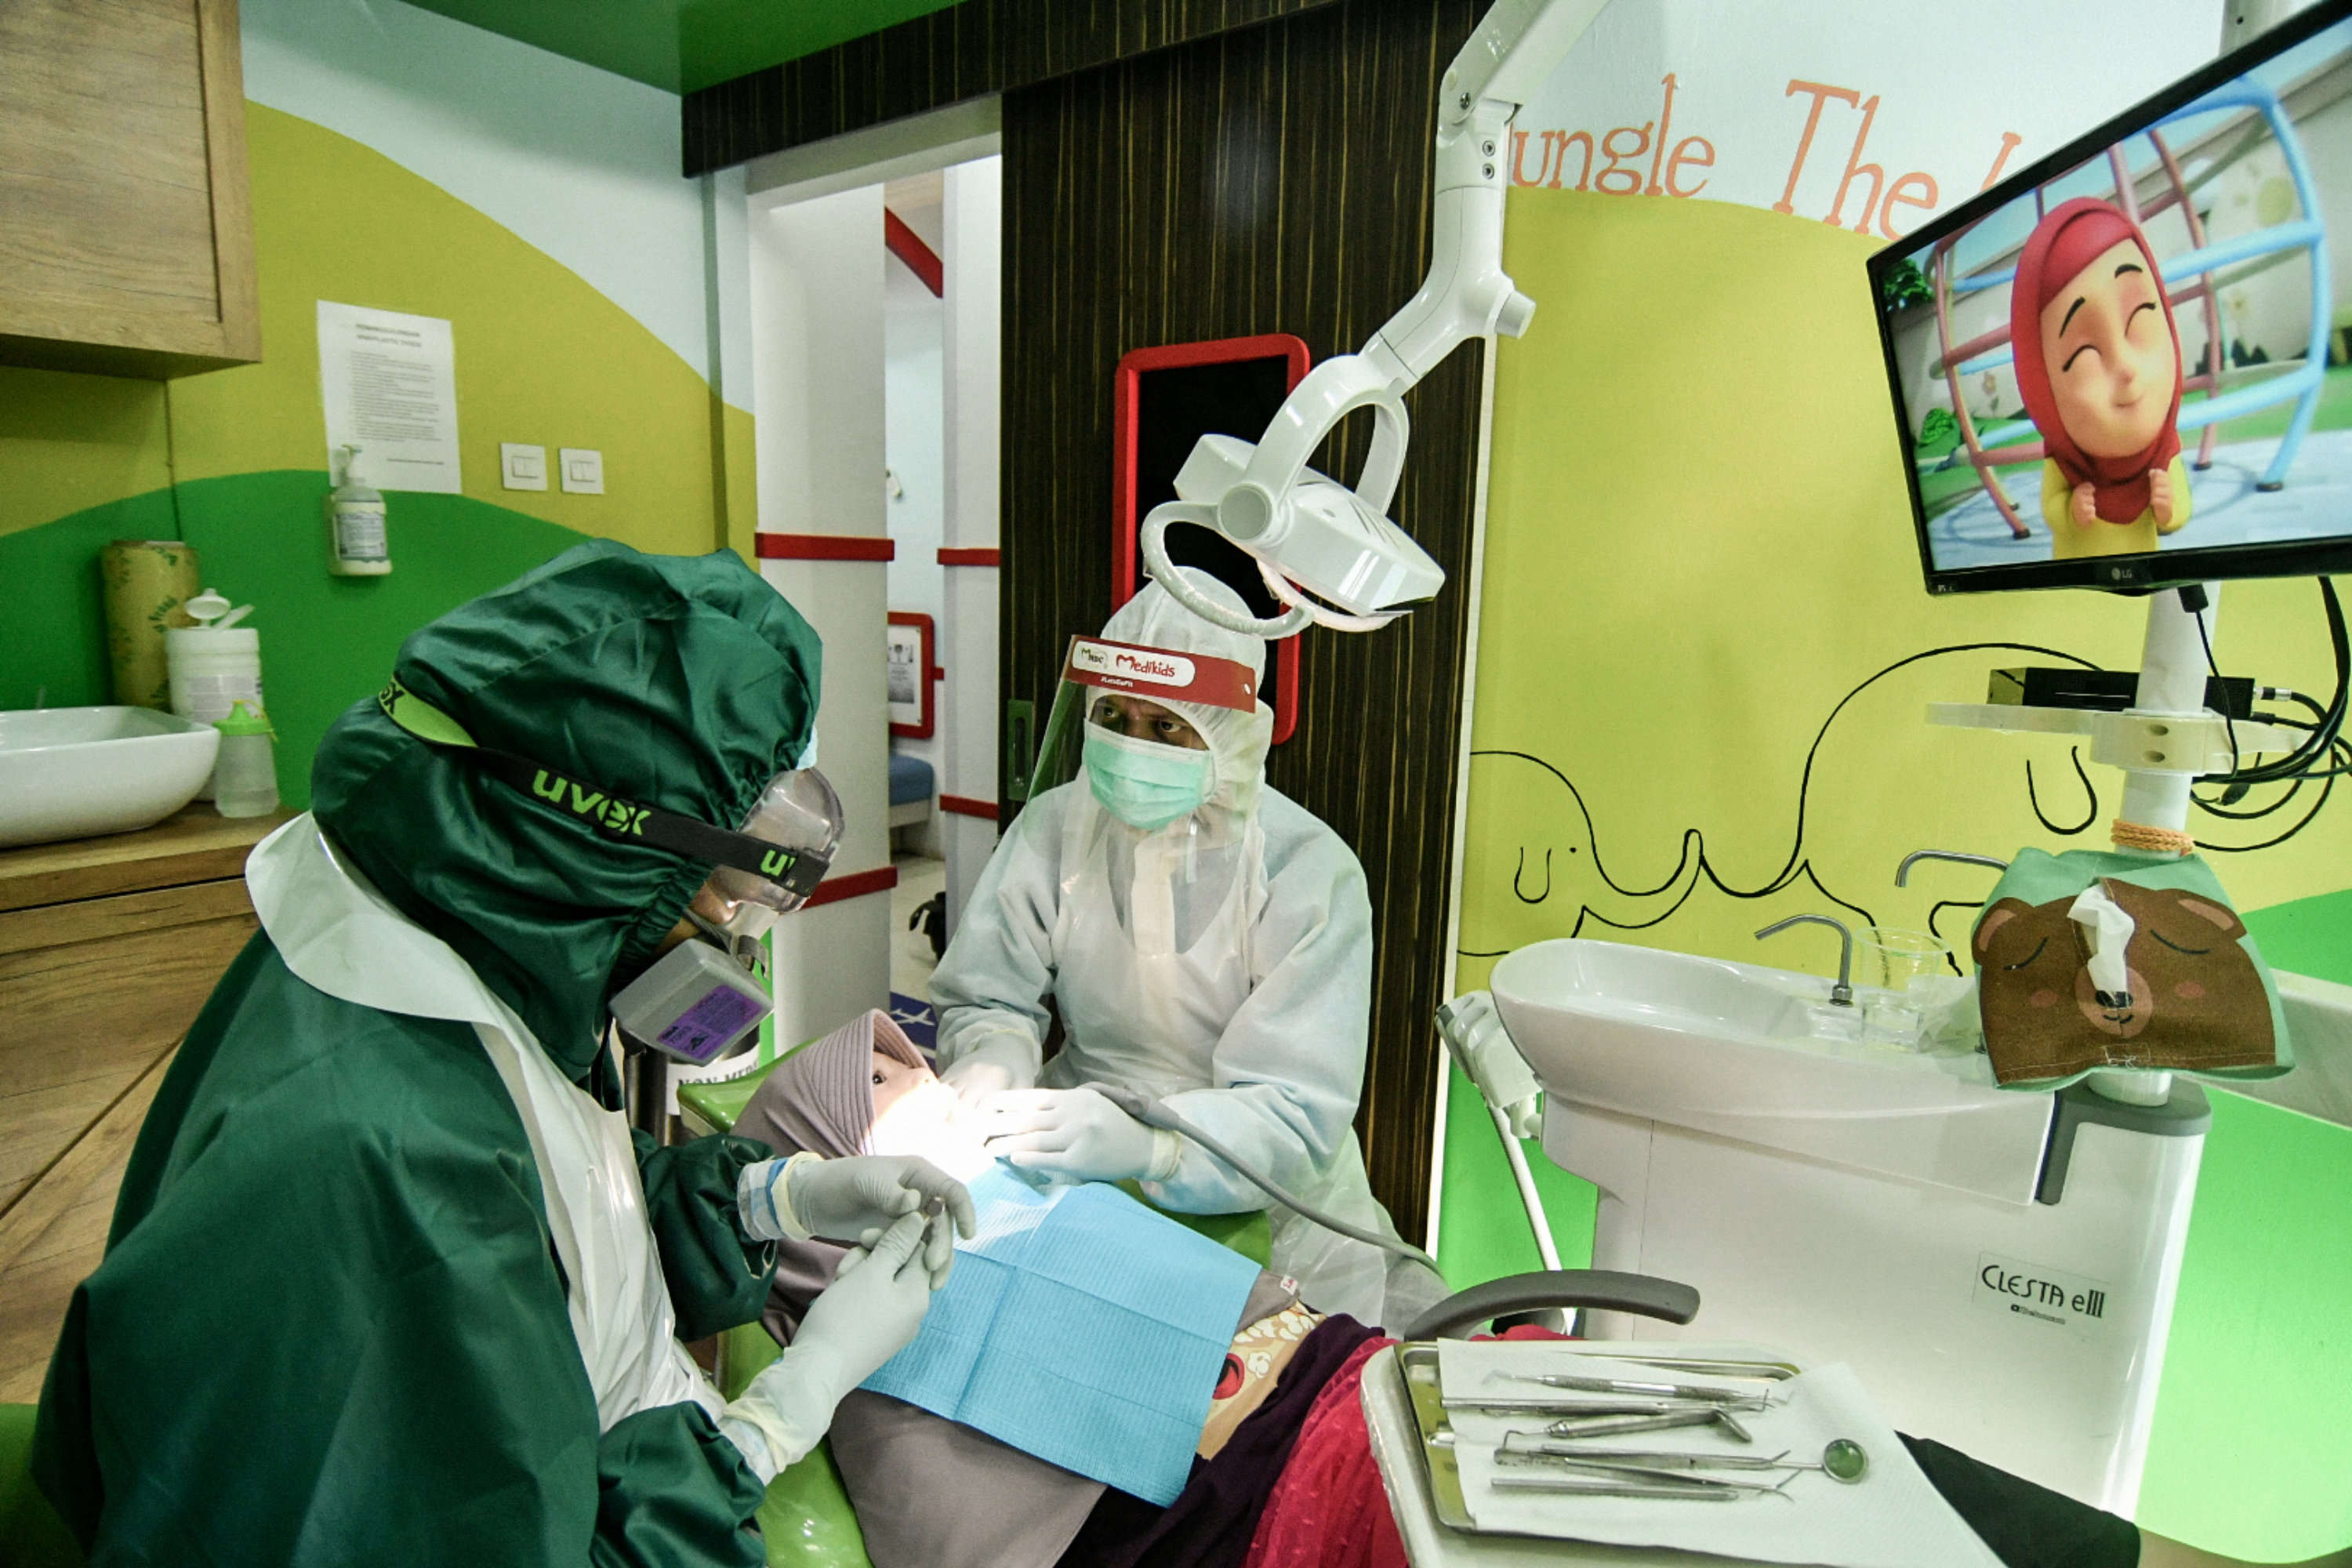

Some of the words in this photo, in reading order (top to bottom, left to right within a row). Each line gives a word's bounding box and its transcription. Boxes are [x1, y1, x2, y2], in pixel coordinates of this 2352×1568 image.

[1510, 73, 1715, 198] ungle
[1772, 78, 1939, 241] The
[1116, 654, 1176, 677] Medikids
[533, 769, 652, 836] uvex
[1981, 1265, 2065, 1307] CLESTA
